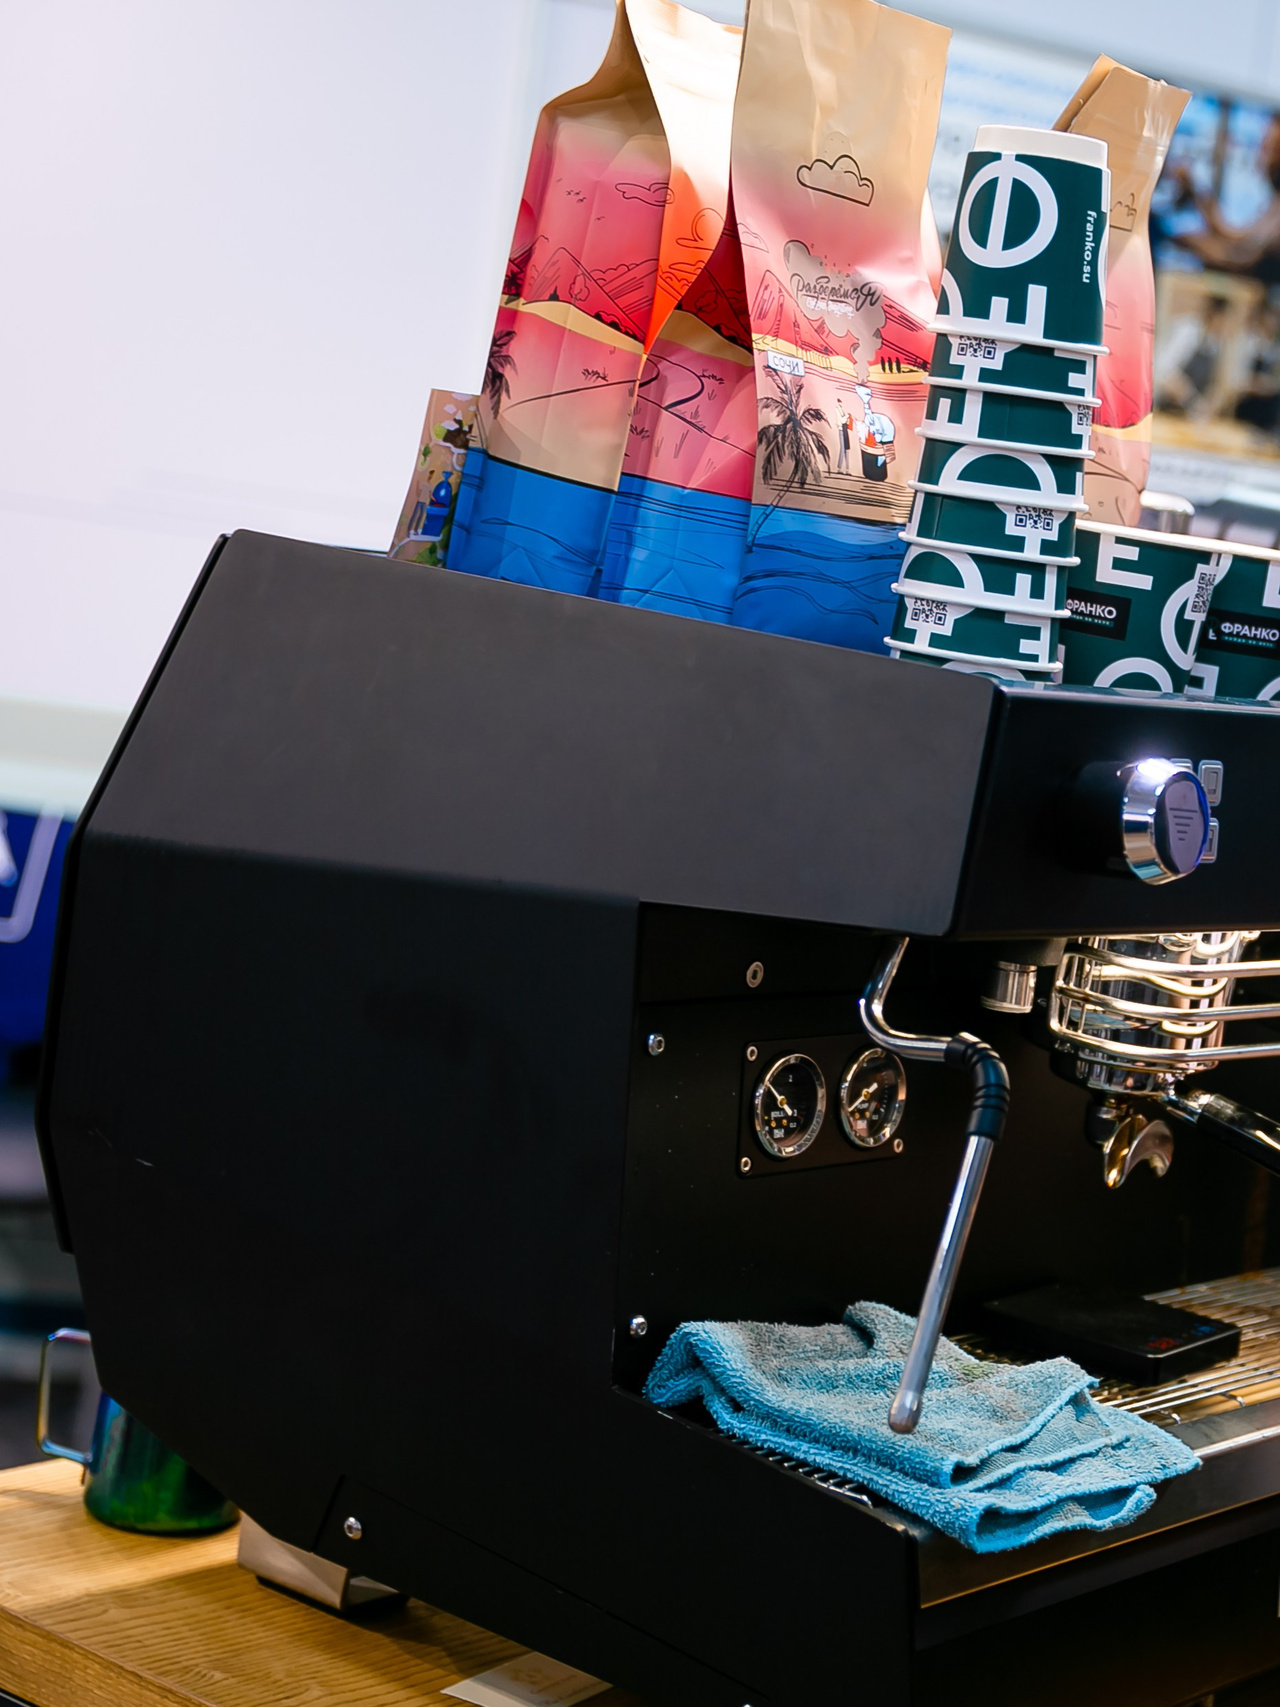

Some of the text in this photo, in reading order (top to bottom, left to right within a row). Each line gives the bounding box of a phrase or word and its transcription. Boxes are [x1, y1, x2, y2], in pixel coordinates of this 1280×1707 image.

[1082, 210, 1097, 283] franko.su
[1066, 599, 1117, 619] ФРАНКО
[1220, 622, 1280, 641] ФРАНКО
